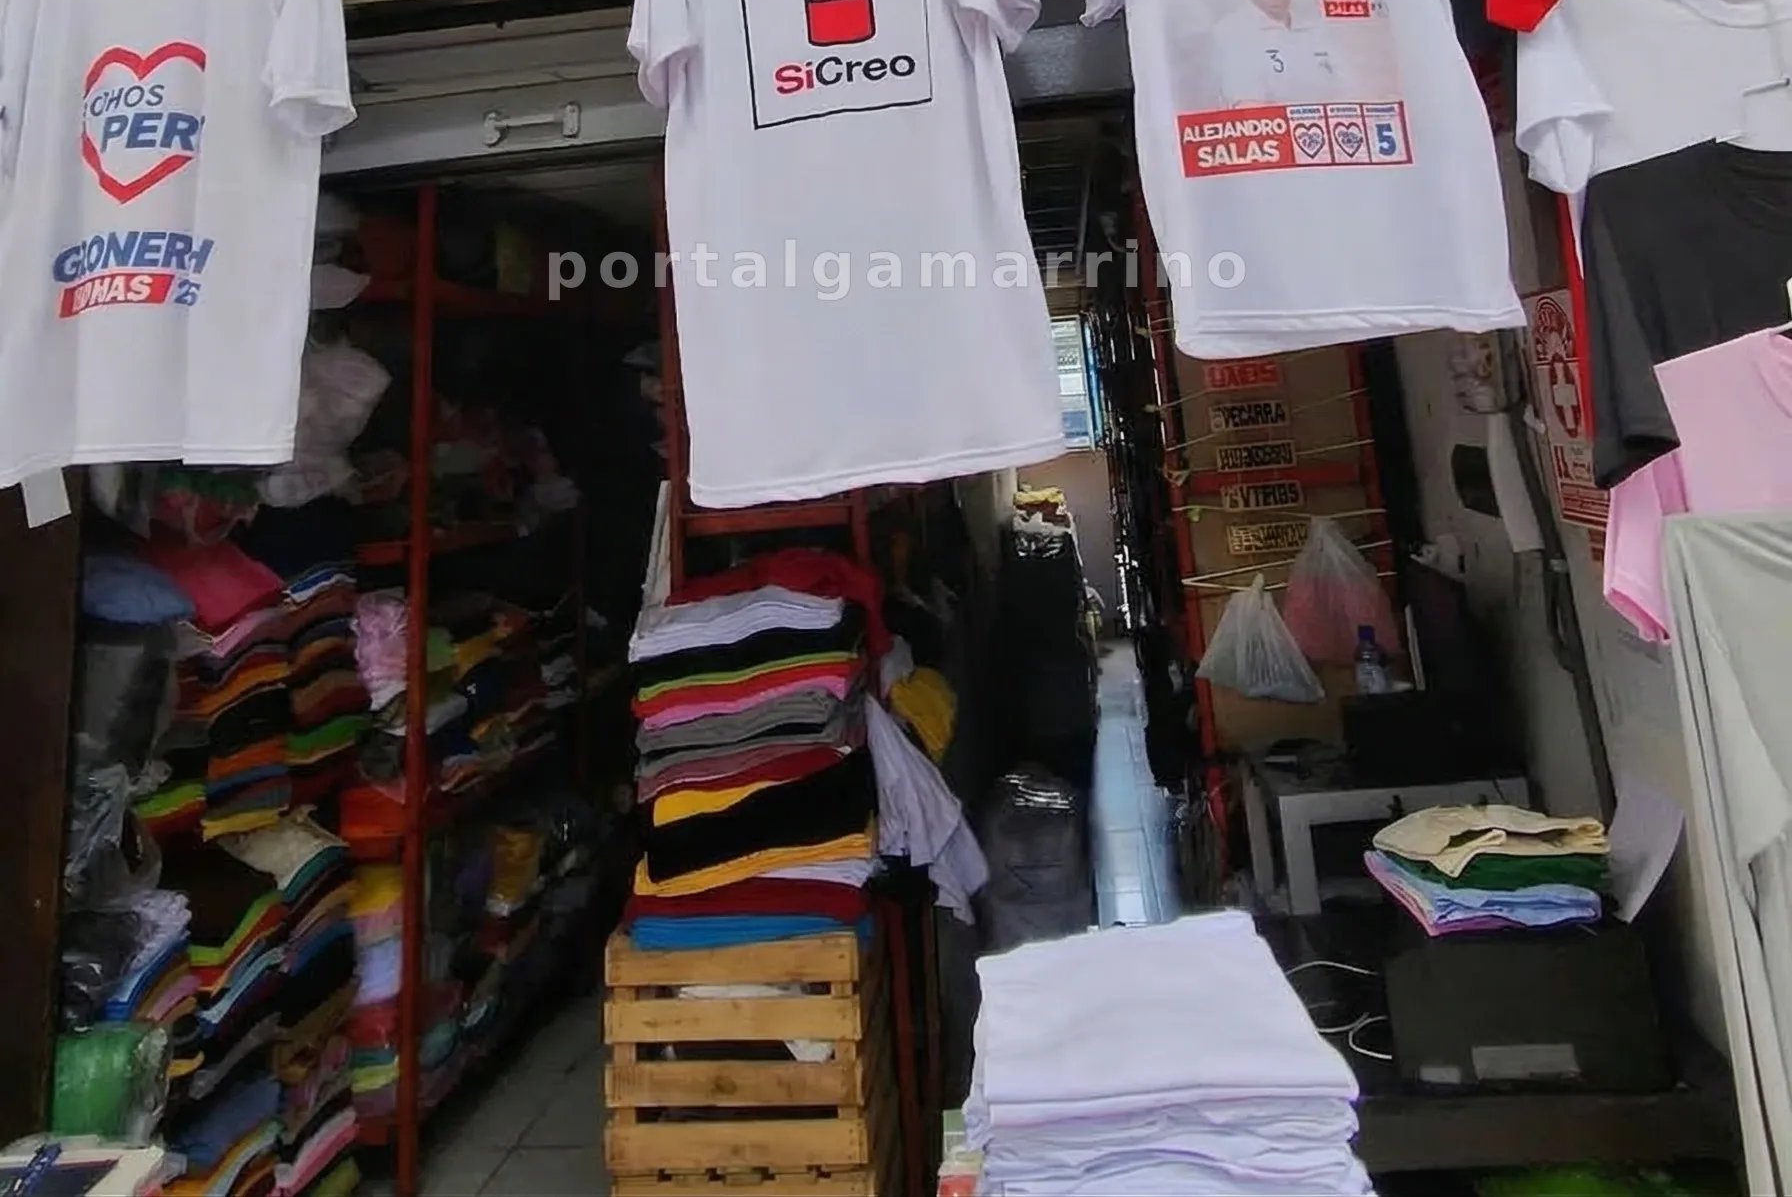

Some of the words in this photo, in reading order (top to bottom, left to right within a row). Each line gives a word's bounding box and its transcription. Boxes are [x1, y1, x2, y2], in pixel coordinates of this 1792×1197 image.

[774, 55, 916, 95] SiCreo
[100, 111, 205, 153] PER
[1375, 123, 1397, 157] 5
[1197, 140, 1281, 169] SALAS
